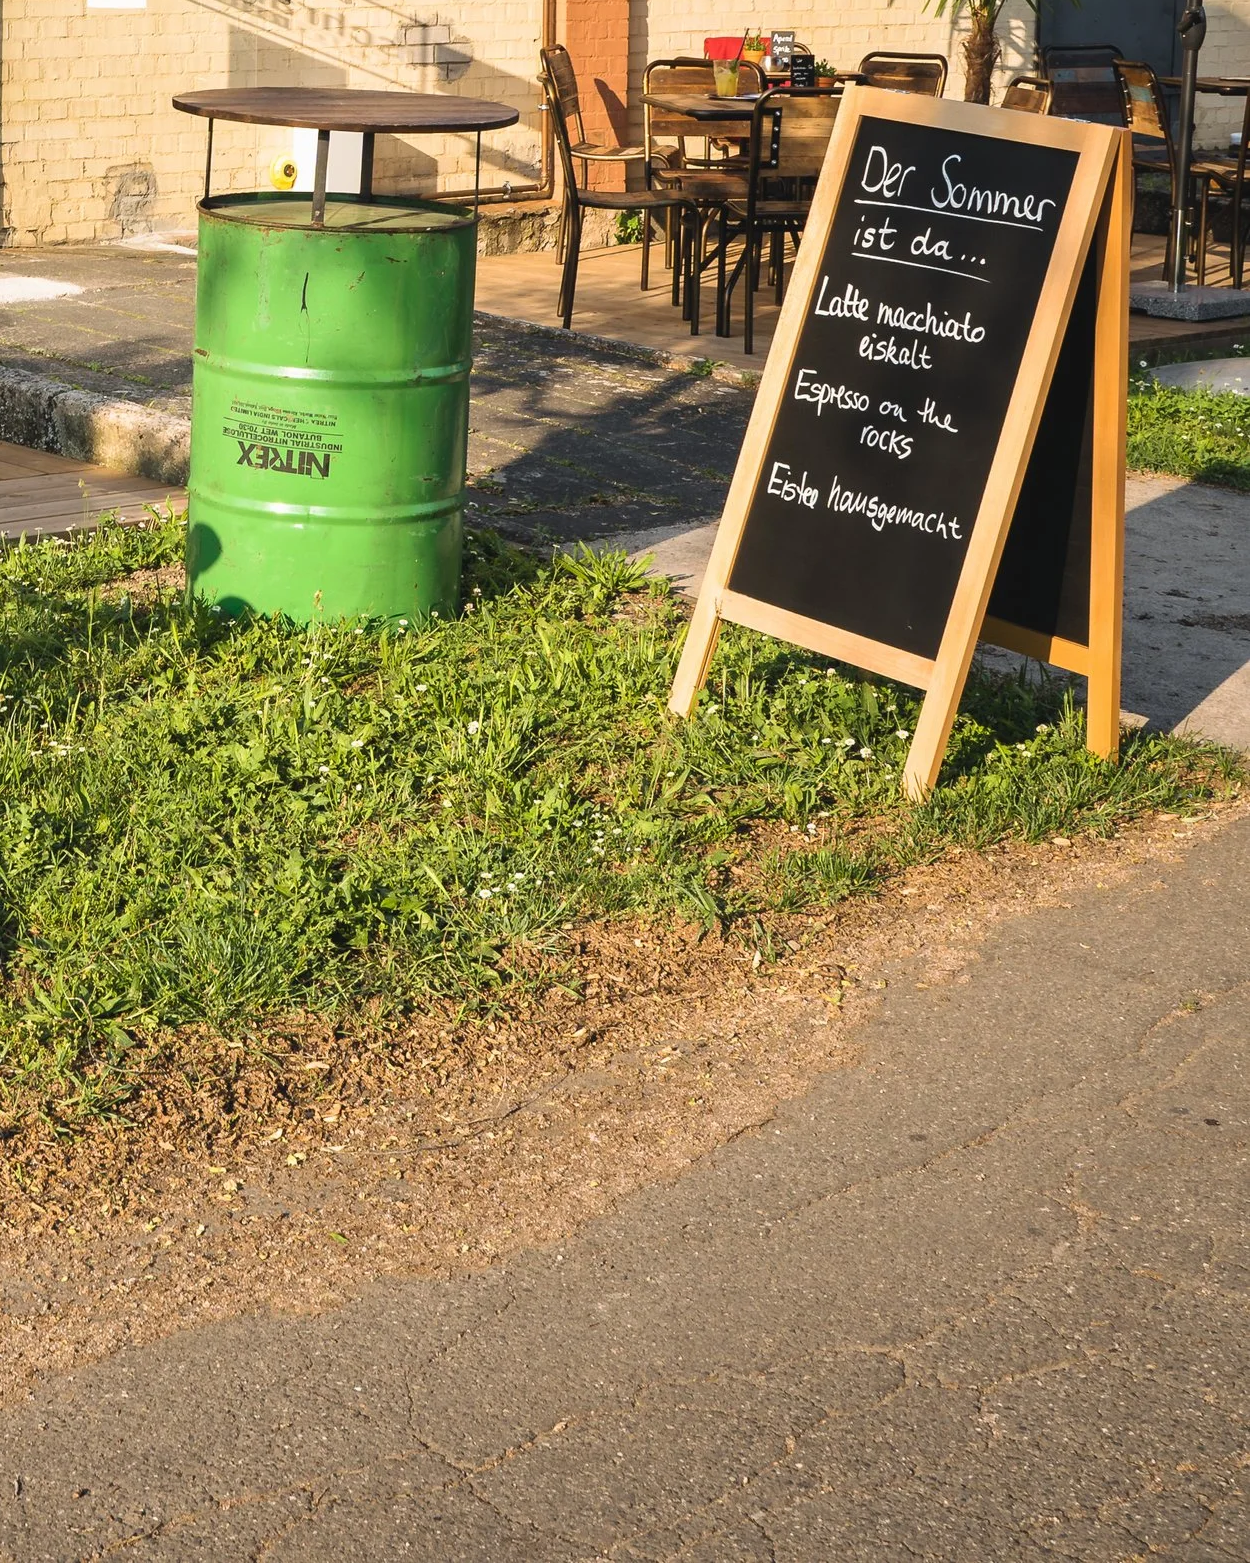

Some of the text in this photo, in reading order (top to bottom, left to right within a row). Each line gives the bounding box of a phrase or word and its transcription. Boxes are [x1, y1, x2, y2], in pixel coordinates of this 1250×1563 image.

[861, 146, 1057, 222] Der Sommer
[853, 217, 897, 251] ist
[814, 275, 986, 344] Latte macchiato
[858, 334, 933, 370] eiskalt
[794, 369, 959, 434] Espresso on the
[222, 426, 343, 452] INDUSTRIAL NITROCELLULOSE
[238, 423, 322, 442] BUTANOL WET 70:30
[860, 424, 915, 460] rocks
[236, 440, 331, 479] NITREX
[766, 461, 963, 541] Eistee hausgemacht
